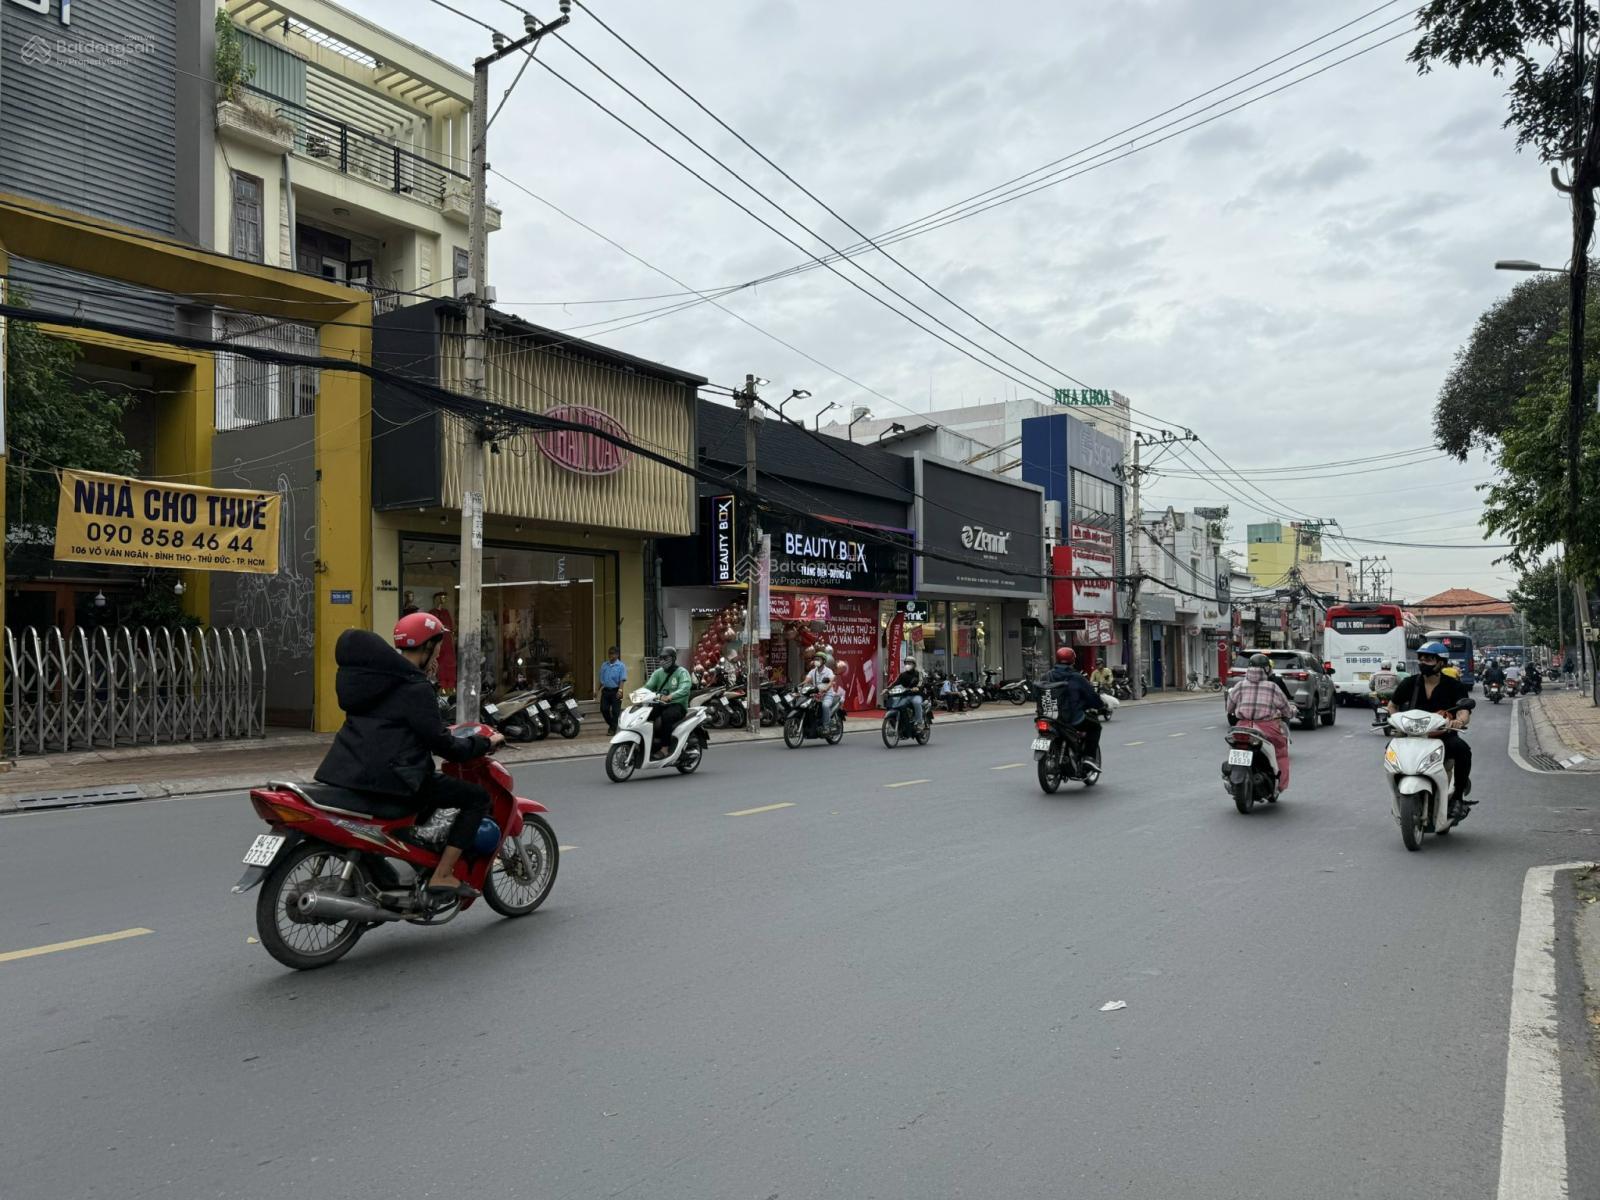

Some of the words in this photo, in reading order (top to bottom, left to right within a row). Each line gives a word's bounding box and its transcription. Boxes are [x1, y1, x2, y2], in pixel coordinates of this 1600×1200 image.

[1081, 389, 1110, 405] KHOA
[74, 479, 134, 518] NHÀ
[143, 489, 197, 524] CHO
[206, 494, 267, 530] THUÊ
[718, 499, 732, 530] BOX
[87, 522, 132, 544] 090
[141, 527, 184, 548] 858
[192, 533, 219, 551] 46
[227, 535, 254, 552] 44
[71, 546, 86, 555] 106
[104, 547, 123, 557] VĂN
[124, 548, 149, 559] NGÂN
[155, 551, 174, 561] BÌNH
[175, 553, 192, 563] THỌ
[198, 553, 212, 563] THỦ
[214, 553, 231, 565] ĐỨC
[248, 558, 265, 566] HCM
[719, 534, 729, 580] BEAUTY
[785, 532, 836, 559] BEAUTY
[839, 541, 868, 573] BOX
[837, 623, 854, 634] HÀNG
[869, 626, 876, 634] 25
